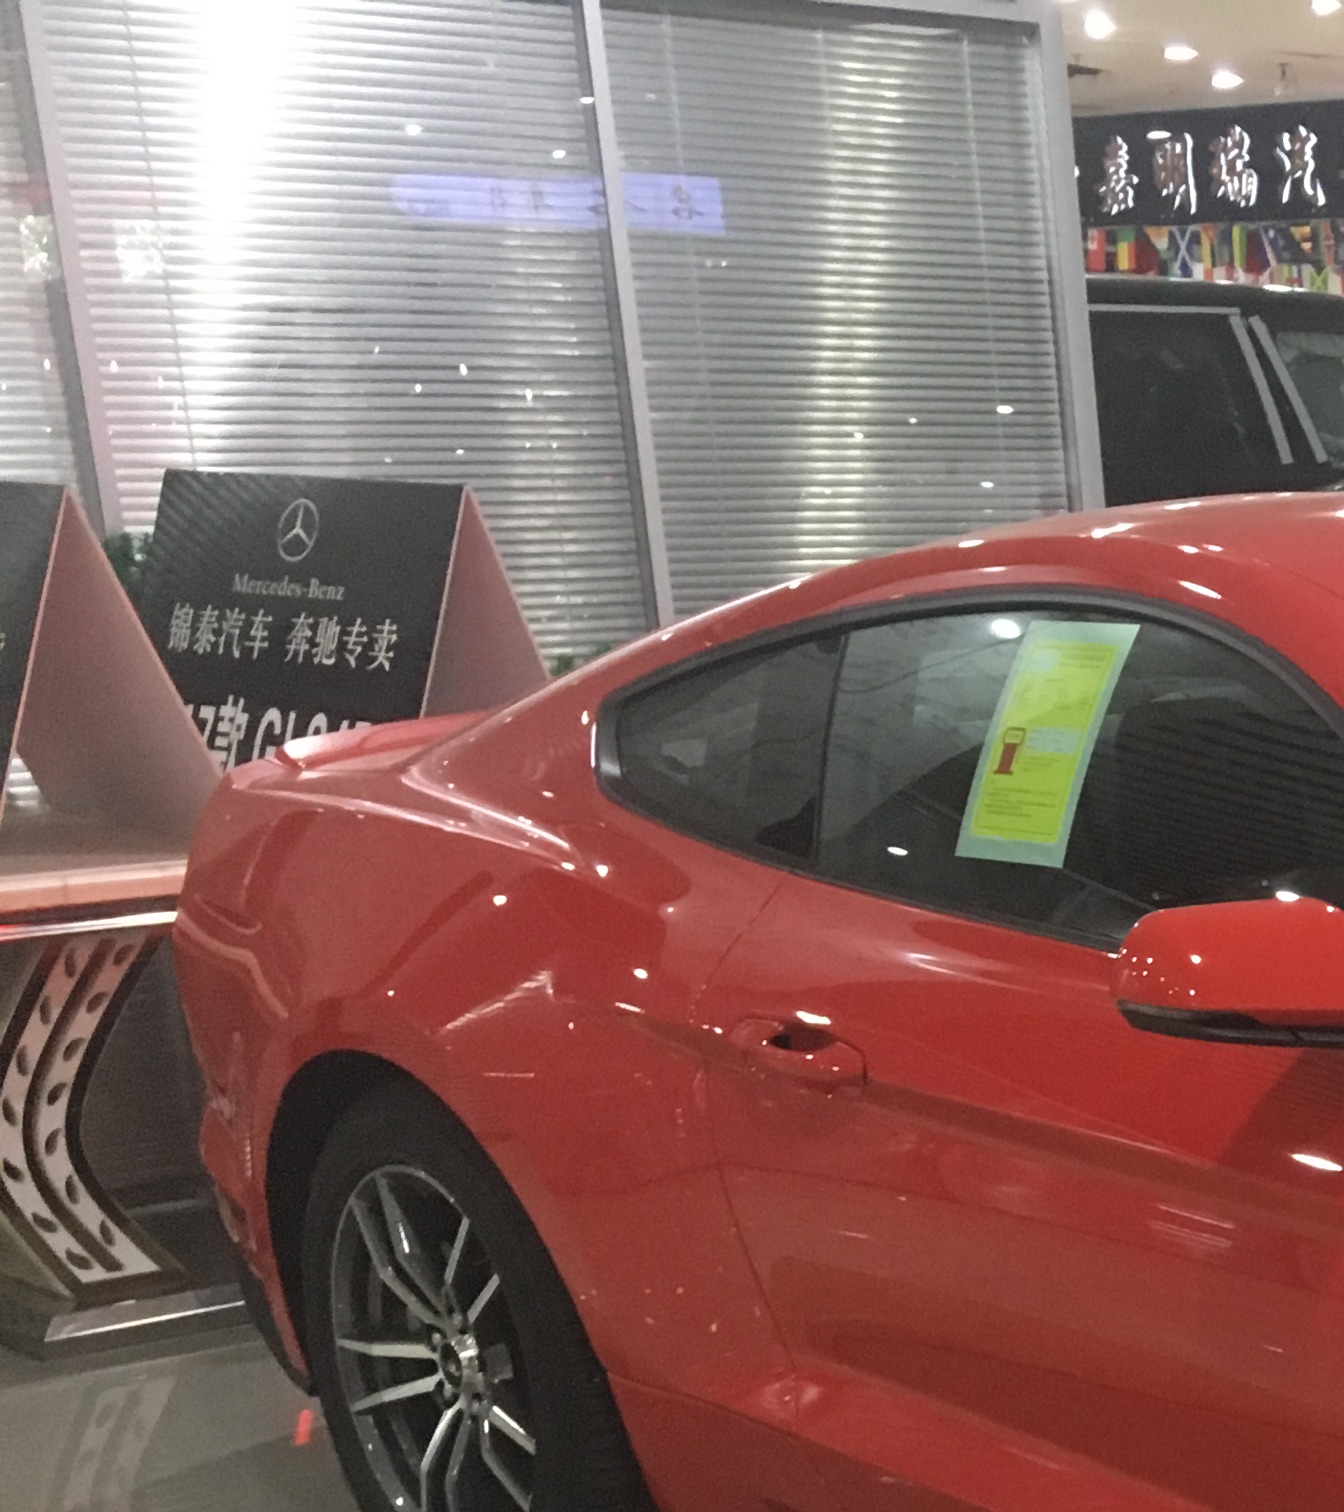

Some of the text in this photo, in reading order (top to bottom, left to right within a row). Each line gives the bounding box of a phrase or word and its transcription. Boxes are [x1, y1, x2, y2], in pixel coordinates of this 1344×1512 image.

[232, 573, 346, 600] Mercedes-Benz
[168, 602, 399, 672] 锦泰汽车 奔驰专卖
